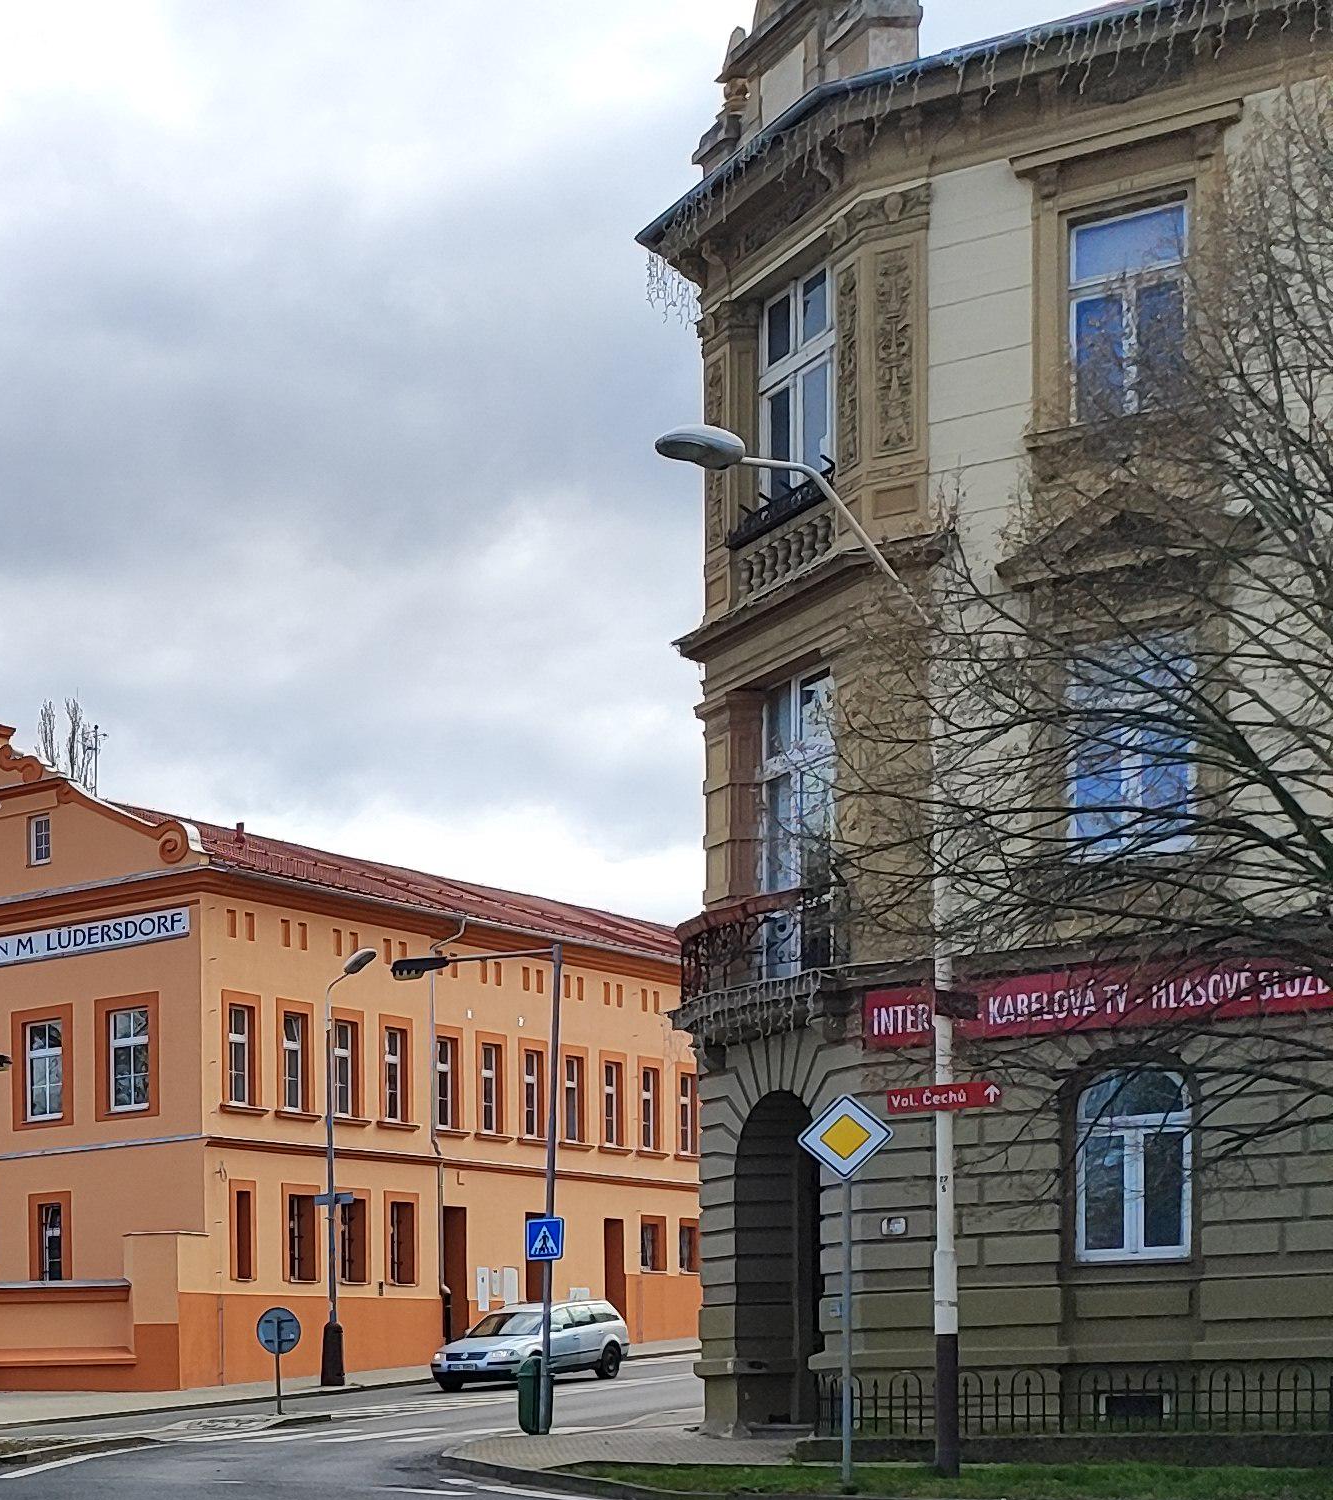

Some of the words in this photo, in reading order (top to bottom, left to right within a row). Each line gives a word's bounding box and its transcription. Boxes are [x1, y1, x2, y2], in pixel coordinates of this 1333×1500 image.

[16, 936, 39, 956] M.
[46, 912, 186, 951] LÜDERSDORF.
[988, 979, 1096, 1025] KABELOVÁ
[1103, 984, 1128, 1013] TV
[1152, 964, 1251, 1009] HLASOVÉ
[891, 1094, 918, 1107] Vol.
[923, 1089, 966, 1105] Čechů
